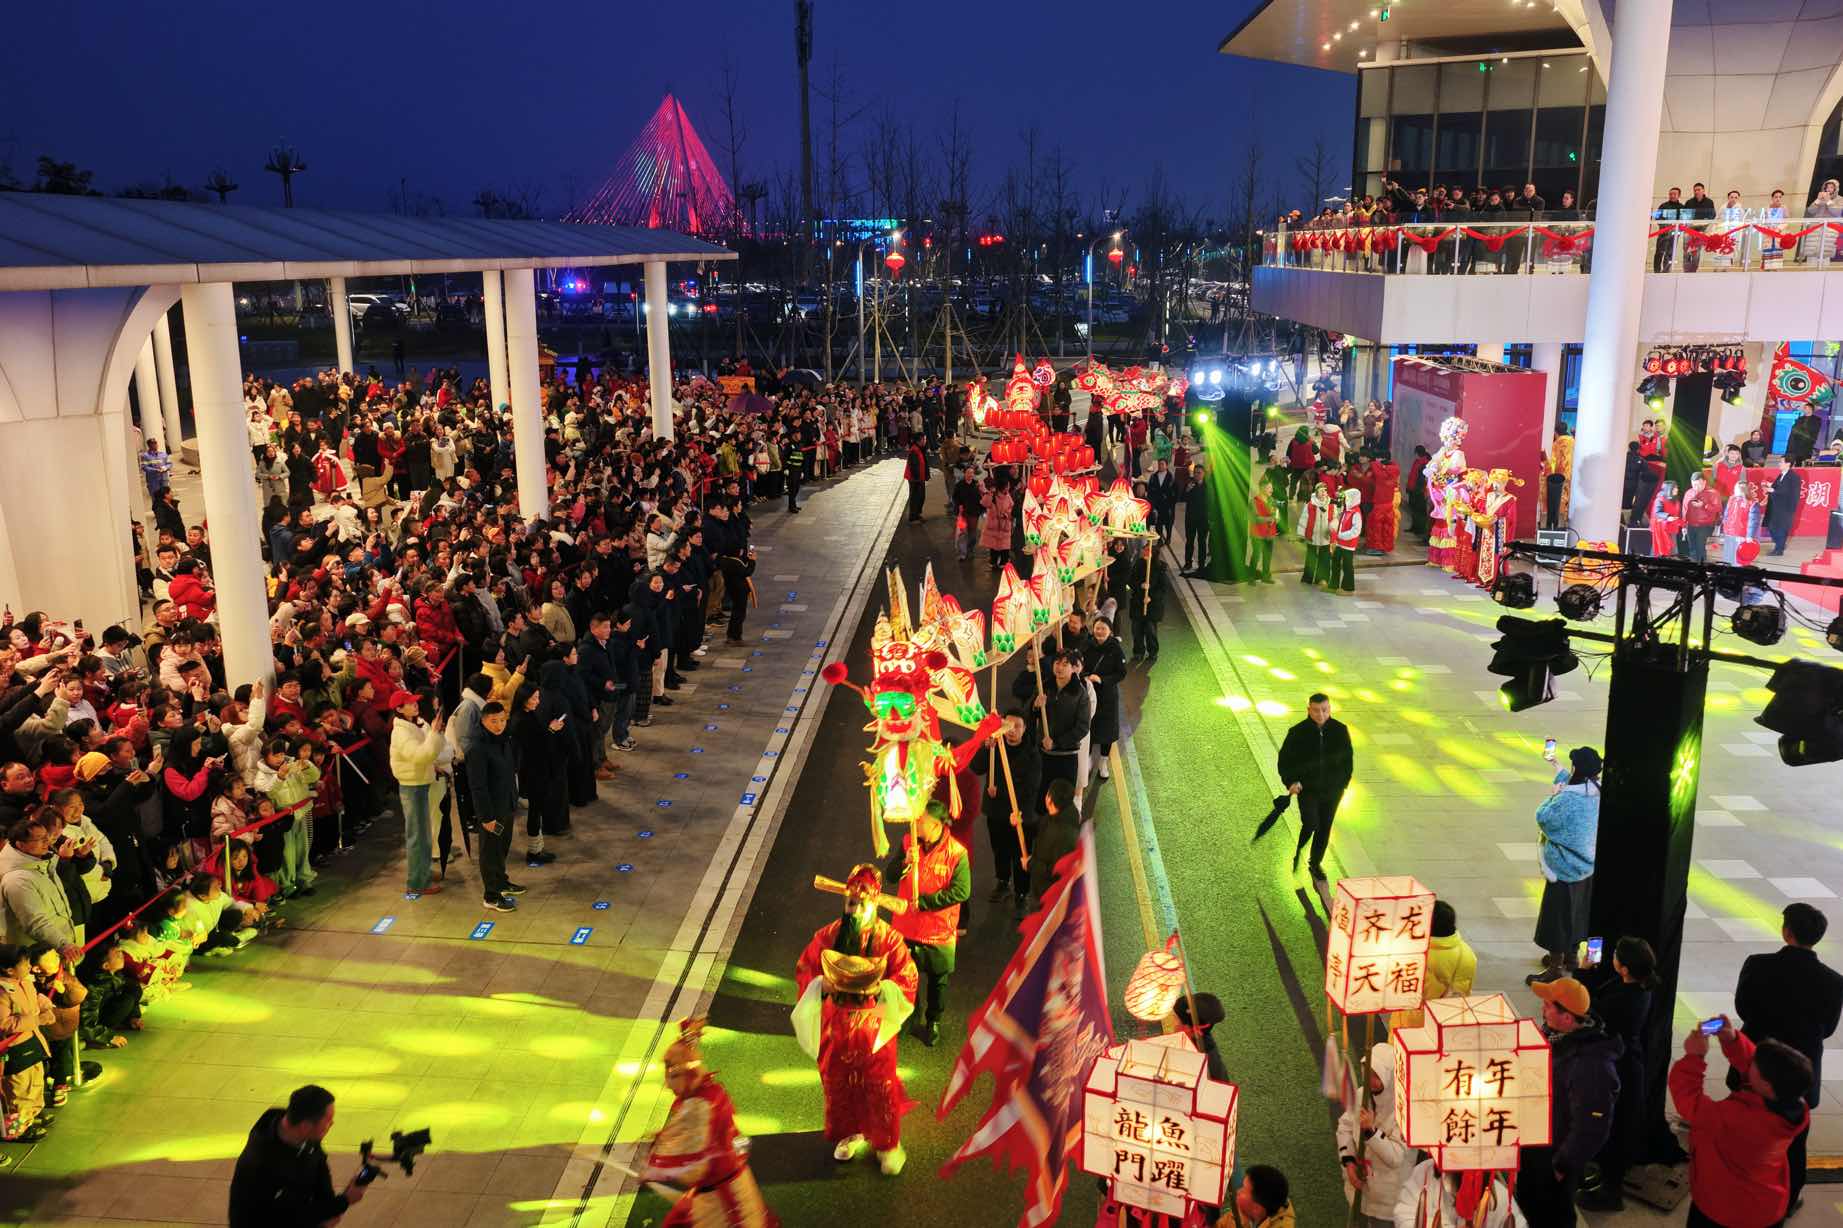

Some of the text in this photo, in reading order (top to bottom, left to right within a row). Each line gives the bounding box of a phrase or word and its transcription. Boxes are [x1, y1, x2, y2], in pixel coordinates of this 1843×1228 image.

[1351, 909, 1392, 995] 齐天
[1384, 905, 1425, 994] 龙福
[1441, 1059, 1478, 1144] 有餘
[1482, 1058, 1518, 1147] 年年
[1114, 1107, 1151, 1182] 龍門
[1150, 1116, 1190, 1192] 魚躍
